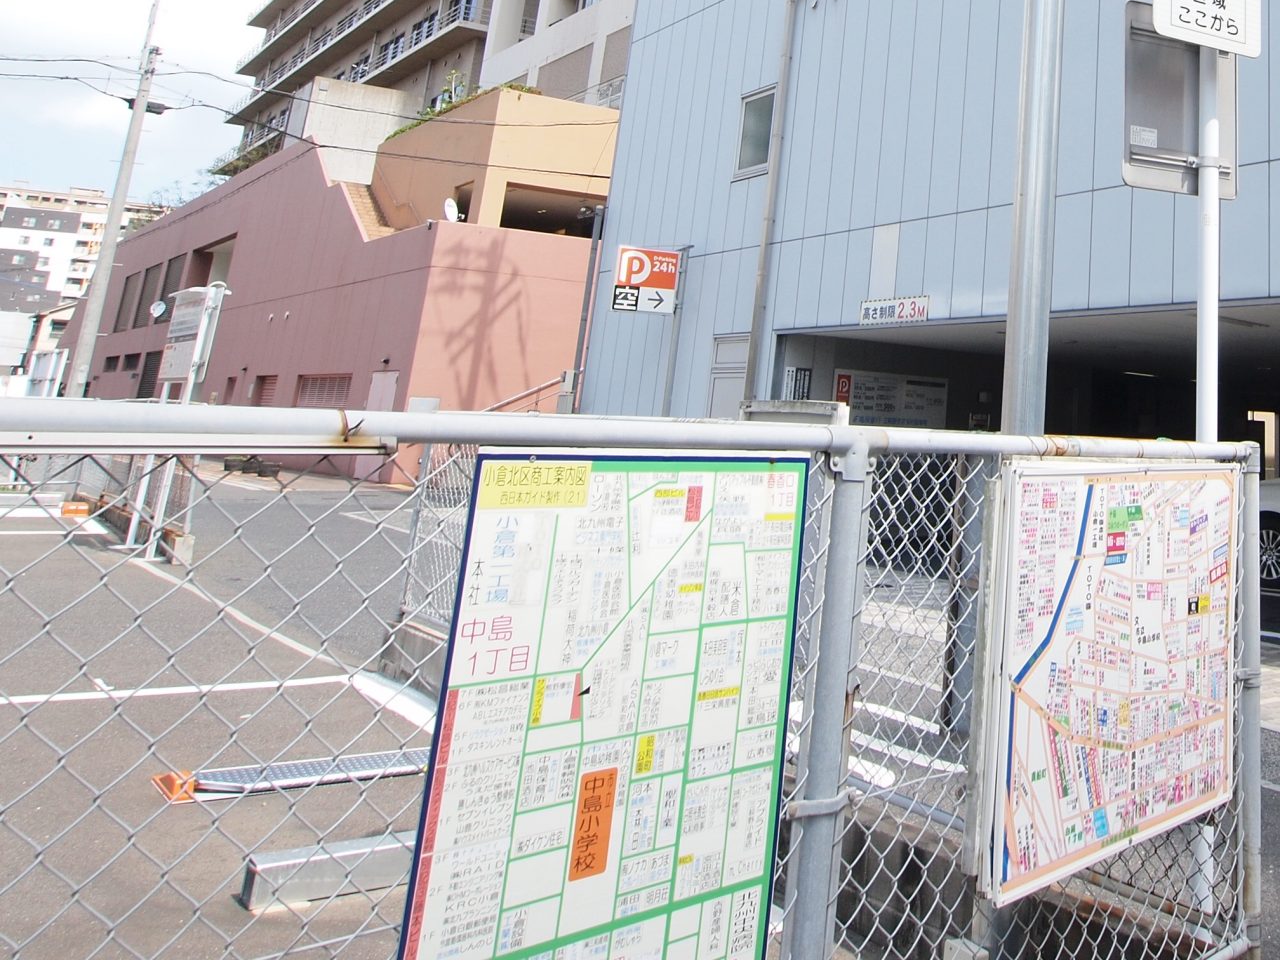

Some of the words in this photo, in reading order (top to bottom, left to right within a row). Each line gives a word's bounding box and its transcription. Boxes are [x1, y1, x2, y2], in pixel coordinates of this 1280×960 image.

[1178, 5, 1240, 37] ここから
[652, 261, 676, 274] 24h
[613, 286, 639, 310] 空
[862, 305, 896, 321] 高さ制限
[897, 300, 926, 320] 2.3M
[484, 465, 588, 487] 小倉北区商工案内図
[468, 558, 486, 606] 本社
[461, 615, 515, 644] 中島
[467, 645, 530, 676] 1丁目
[573, 775, 606, 874] 中島小学校
